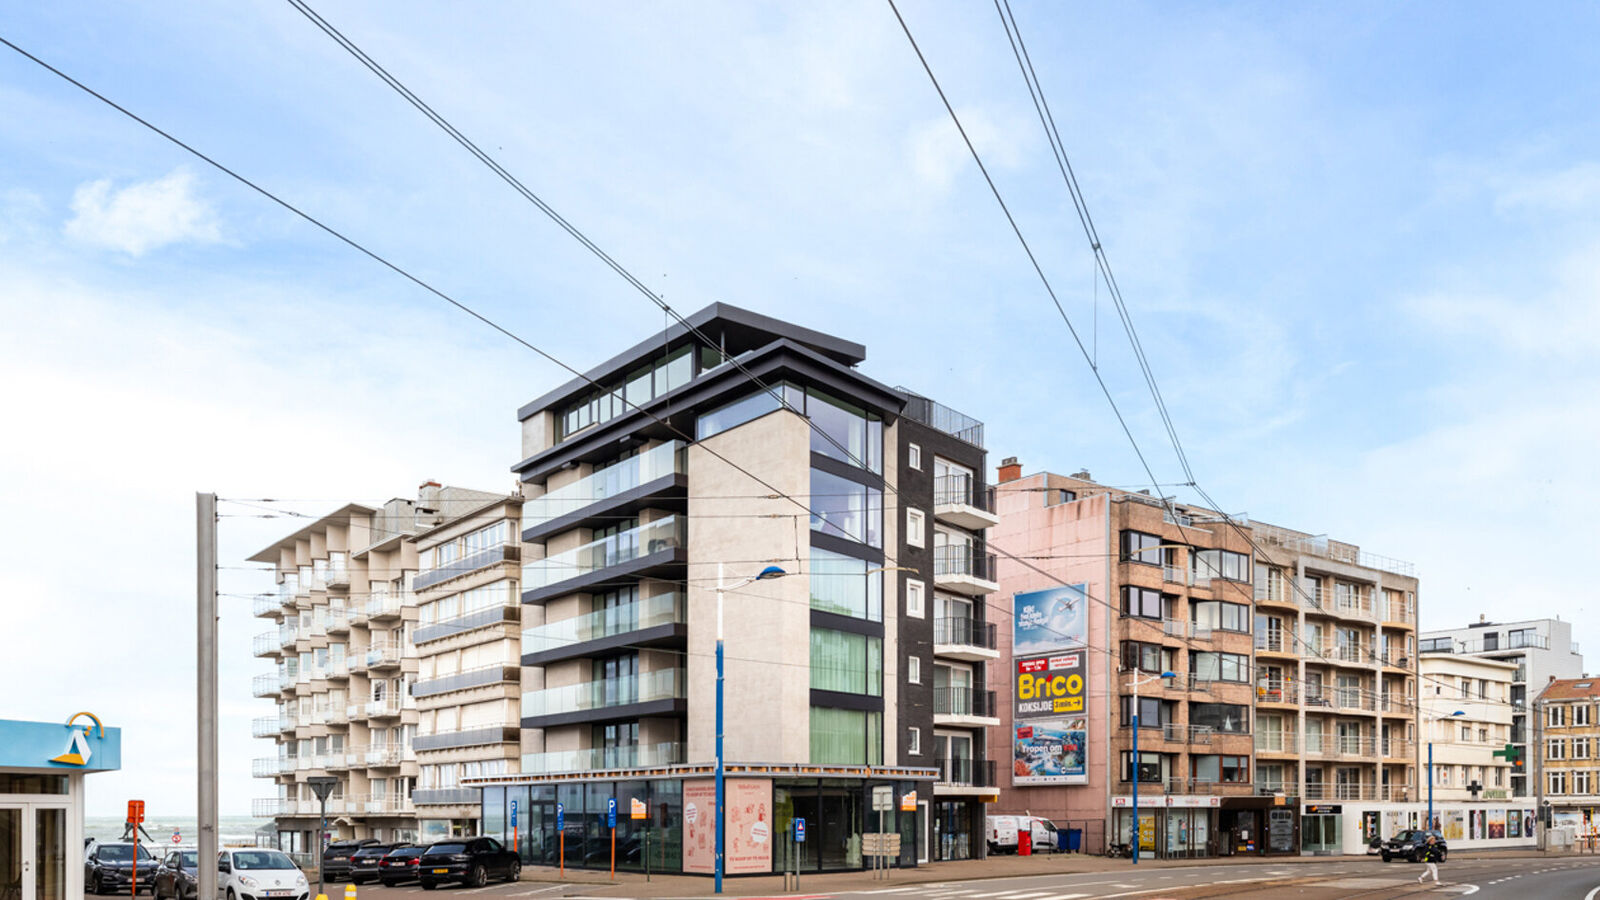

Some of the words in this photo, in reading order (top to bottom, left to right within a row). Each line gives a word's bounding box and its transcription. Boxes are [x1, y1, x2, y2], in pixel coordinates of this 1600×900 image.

[1018, 673, 1083, 700] Brico
[1018, 700, 1053, 713] KOKSIJDE
[1022, 744, 1049, 753] Tropen
[608, 800, 615, 813] P
